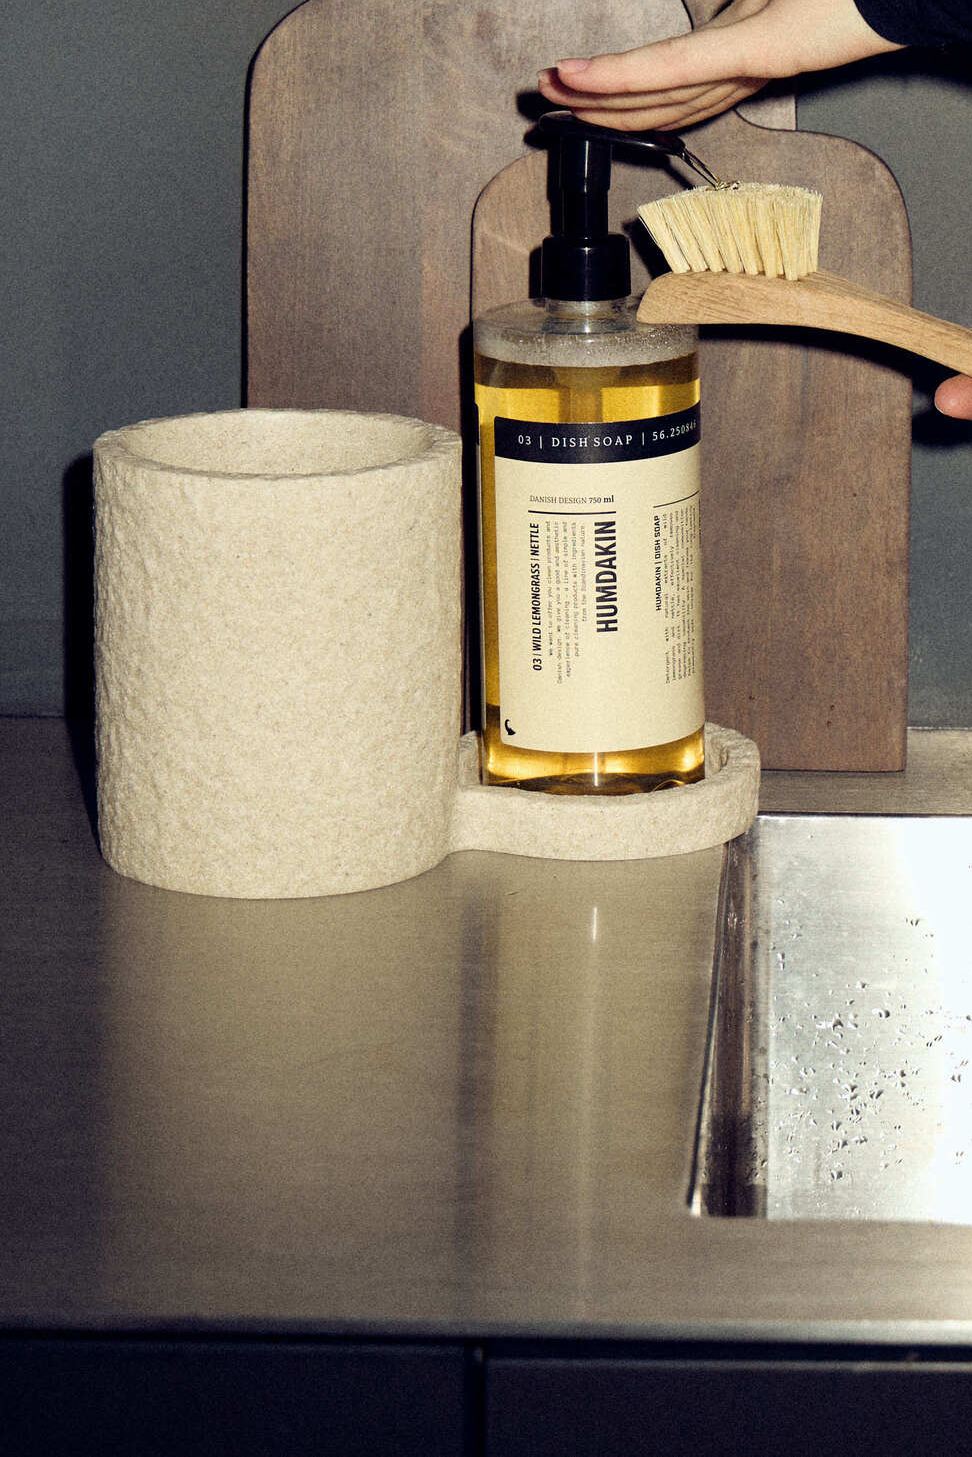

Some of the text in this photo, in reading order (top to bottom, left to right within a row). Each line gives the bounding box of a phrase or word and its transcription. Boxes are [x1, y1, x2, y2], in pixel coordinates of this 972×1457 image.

[518, 435, 531, 445] 03
[552, 437, 588, 447] DISH
[594, 435, 632, 447] SOAP
[530, 495, 556, 503] DANISH
[530, 523, 539, 556] NETTLE
[594, 521, 618, 632] HUMDAKIN
[531, 563, 541, 625] LEMONGRASS
[532, 628, 541, 651] WILD
[533, 658, 542, 671] 03
